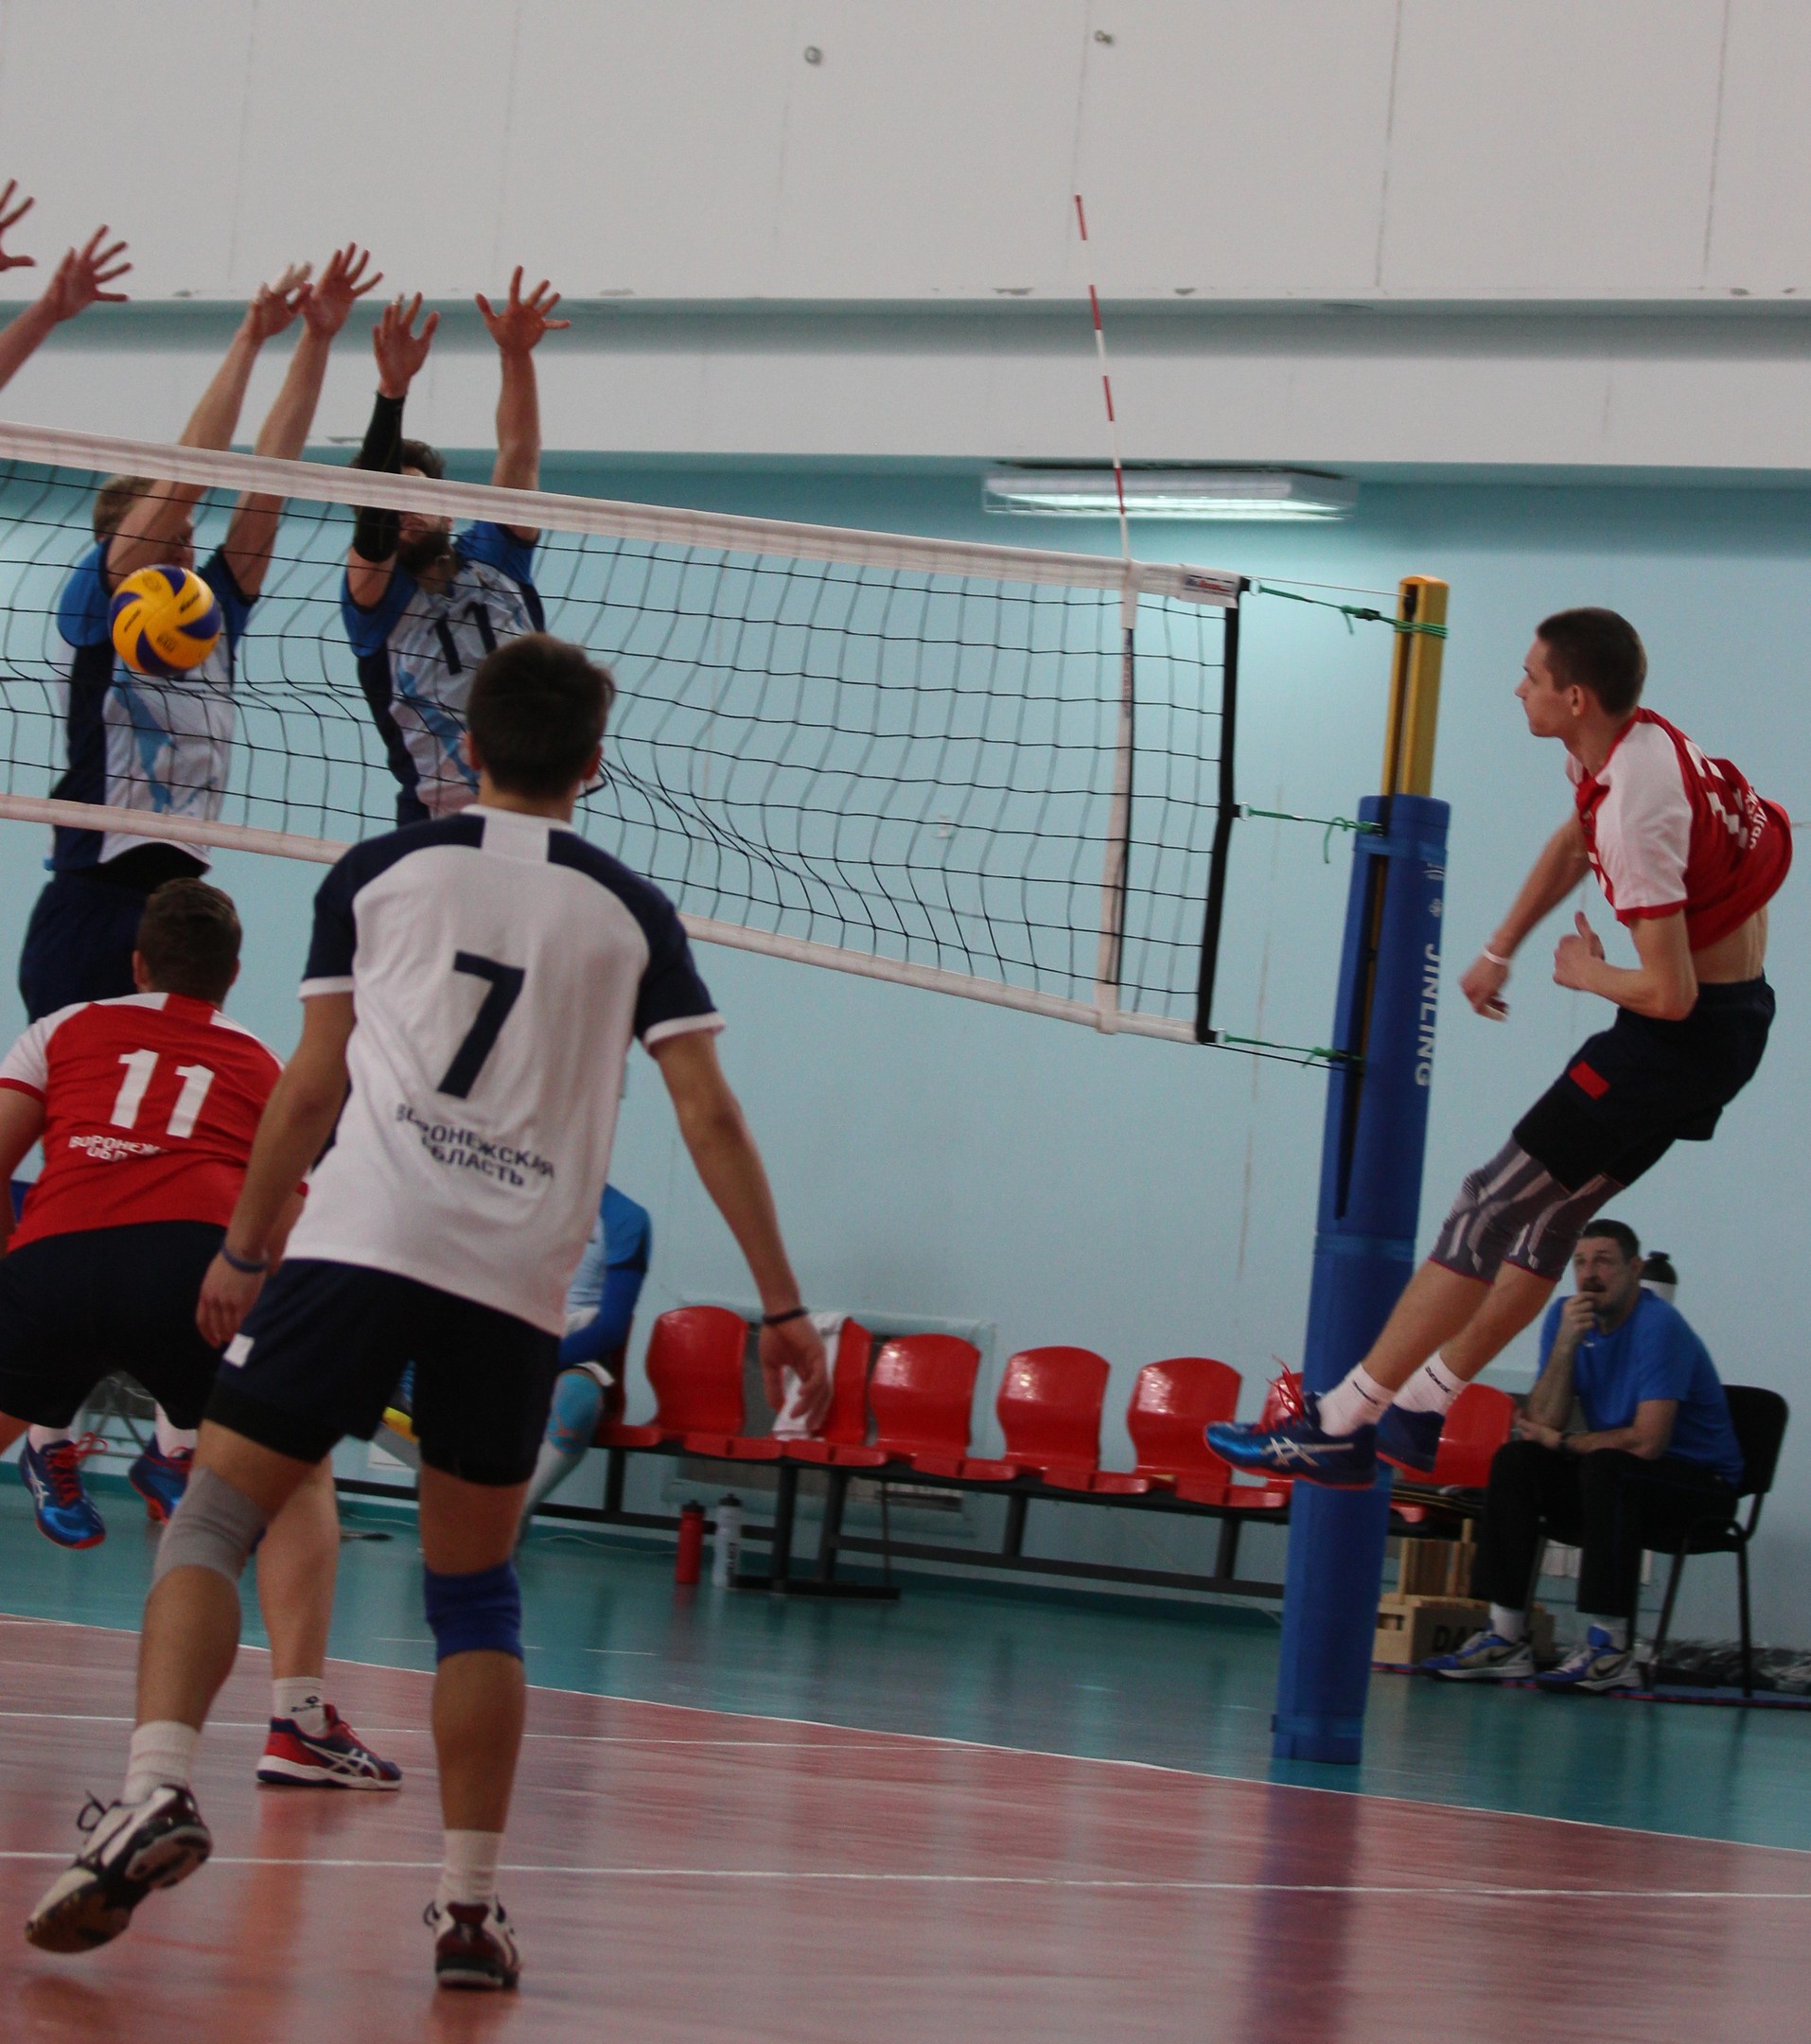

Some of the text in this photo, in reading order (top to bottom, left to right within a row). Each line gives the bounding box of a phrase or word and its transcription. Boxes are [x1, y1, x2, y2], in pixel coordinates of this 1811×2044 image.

[427, 601, 498, 676] 11
[438, 950, 526, 1100] 7
[1415, 943, 1441, 1086] JINLING
[110, 1048, 215, 1139] 11
